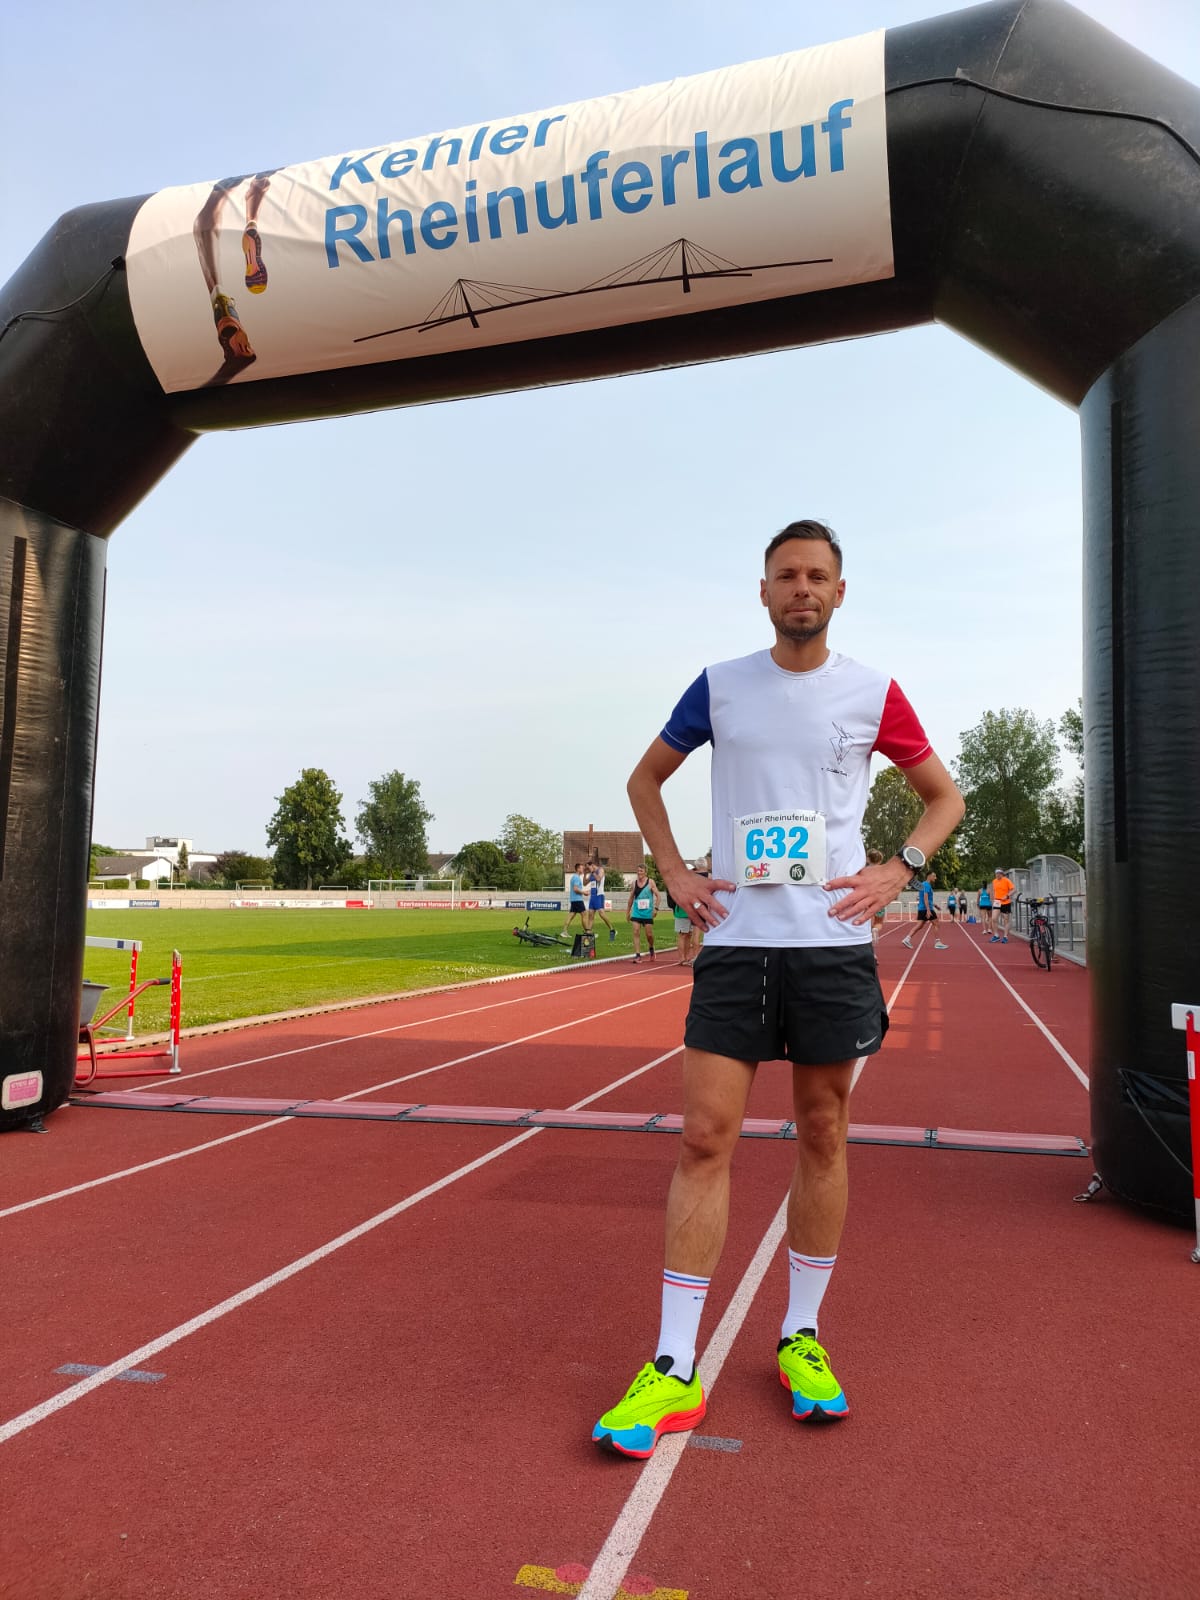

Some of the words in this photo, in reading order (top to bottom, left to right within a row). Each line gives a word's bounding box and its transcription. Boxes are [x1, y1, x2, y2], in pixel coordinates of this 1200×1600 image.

[324, 99, 854, 269] Rheinuferlauf
[329, 115, 567, 190] Kehler
[746, 826, 809, 861] 632
